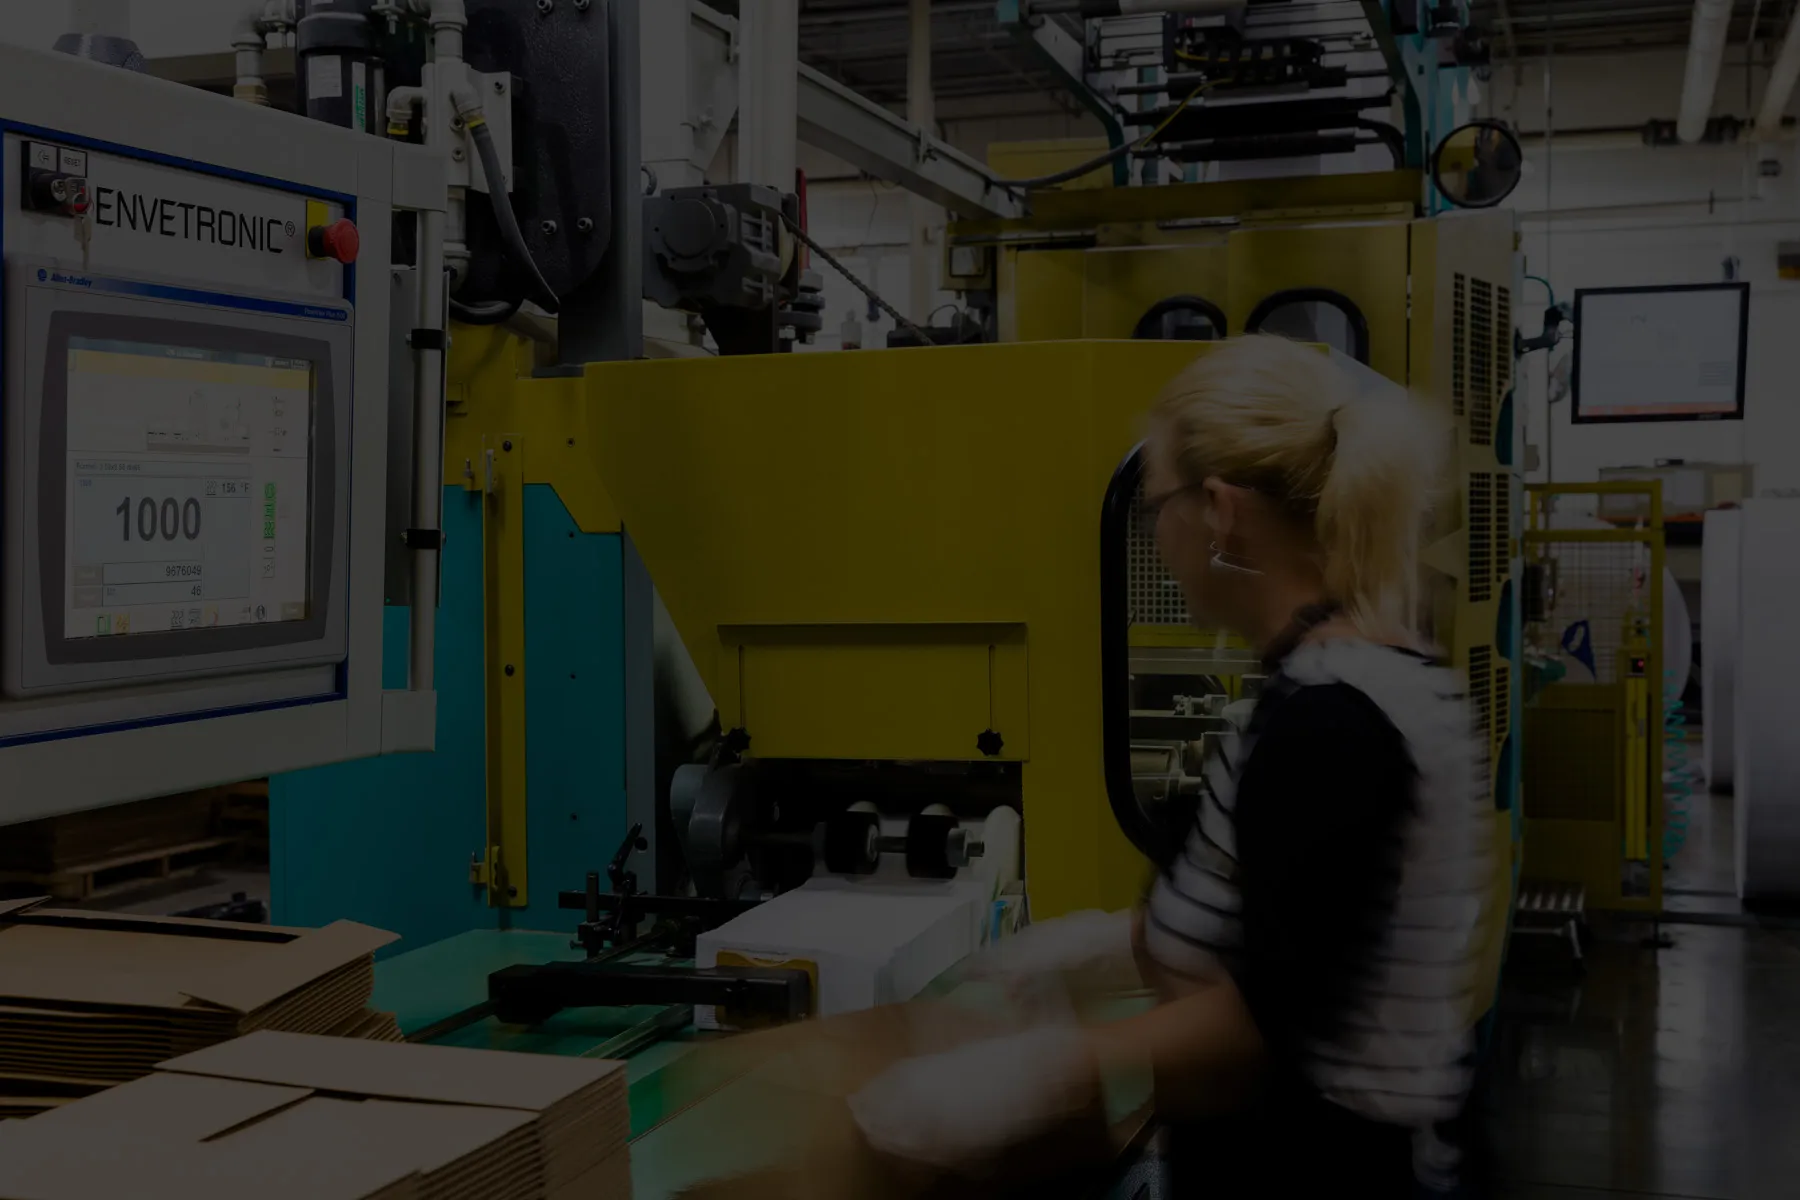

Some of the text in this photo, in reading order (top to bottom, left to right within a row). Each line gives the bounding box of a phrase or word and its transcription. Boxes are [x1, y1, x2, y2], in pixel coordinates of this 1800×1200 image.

[116, 496, 202, 542] 1000
[165, 564, 202, 577] 9676049
[190, 585, 202, 596] 46
